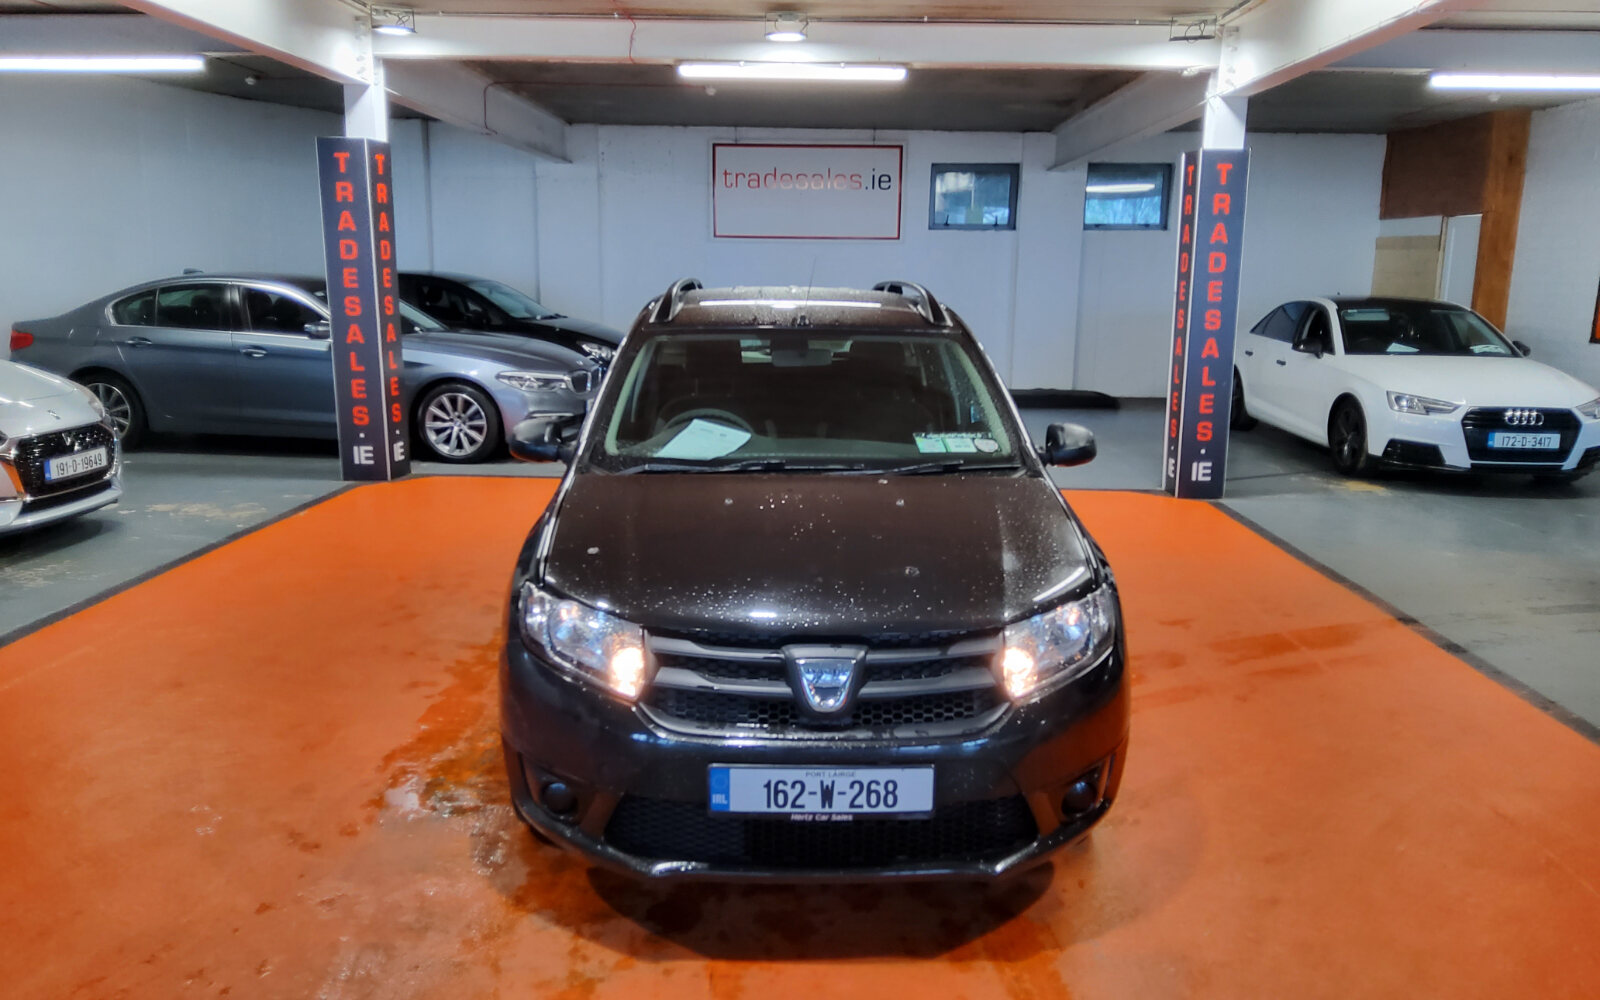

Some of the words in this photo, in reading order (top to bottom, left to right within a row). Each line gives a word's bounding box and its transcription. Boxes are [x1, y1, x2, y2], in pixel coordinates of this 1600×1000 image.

[722, 167, 892, 191] tradesales.ie
[1501, 436, 1552, 447] 172-D-3417
[56, 453, 102, 476] 191-D-19649
[712, 793, 728, 804] IRL
[763, 779, 898, 809] 162-W-268
[791, 813, 813, 821] Hertz
[815, 813, 829, 821] Car
[831, 813, 853, 821] Sales
